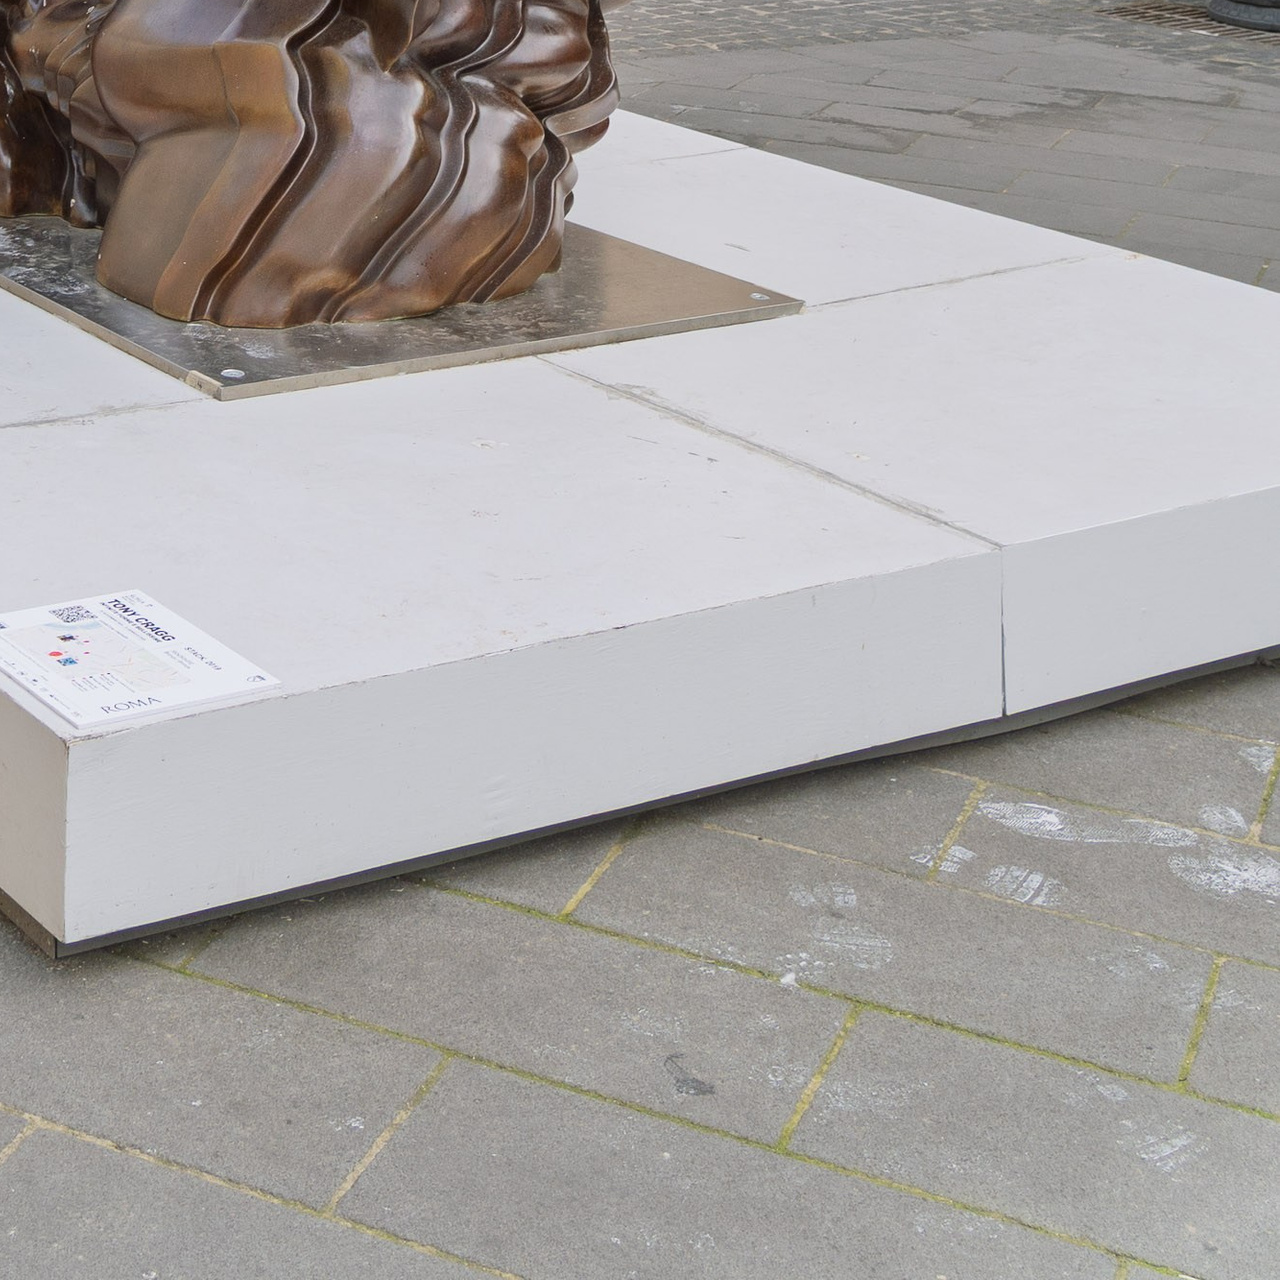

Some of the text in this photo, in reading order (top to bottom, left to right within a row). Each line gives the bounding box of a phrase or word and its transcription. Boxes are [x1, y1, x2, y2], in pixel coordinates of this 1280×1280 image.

[108, 598, 140, 617] TONY
[135, 617, 176, 642] CRAGG
[101, 696, 162, 714] ROMA
